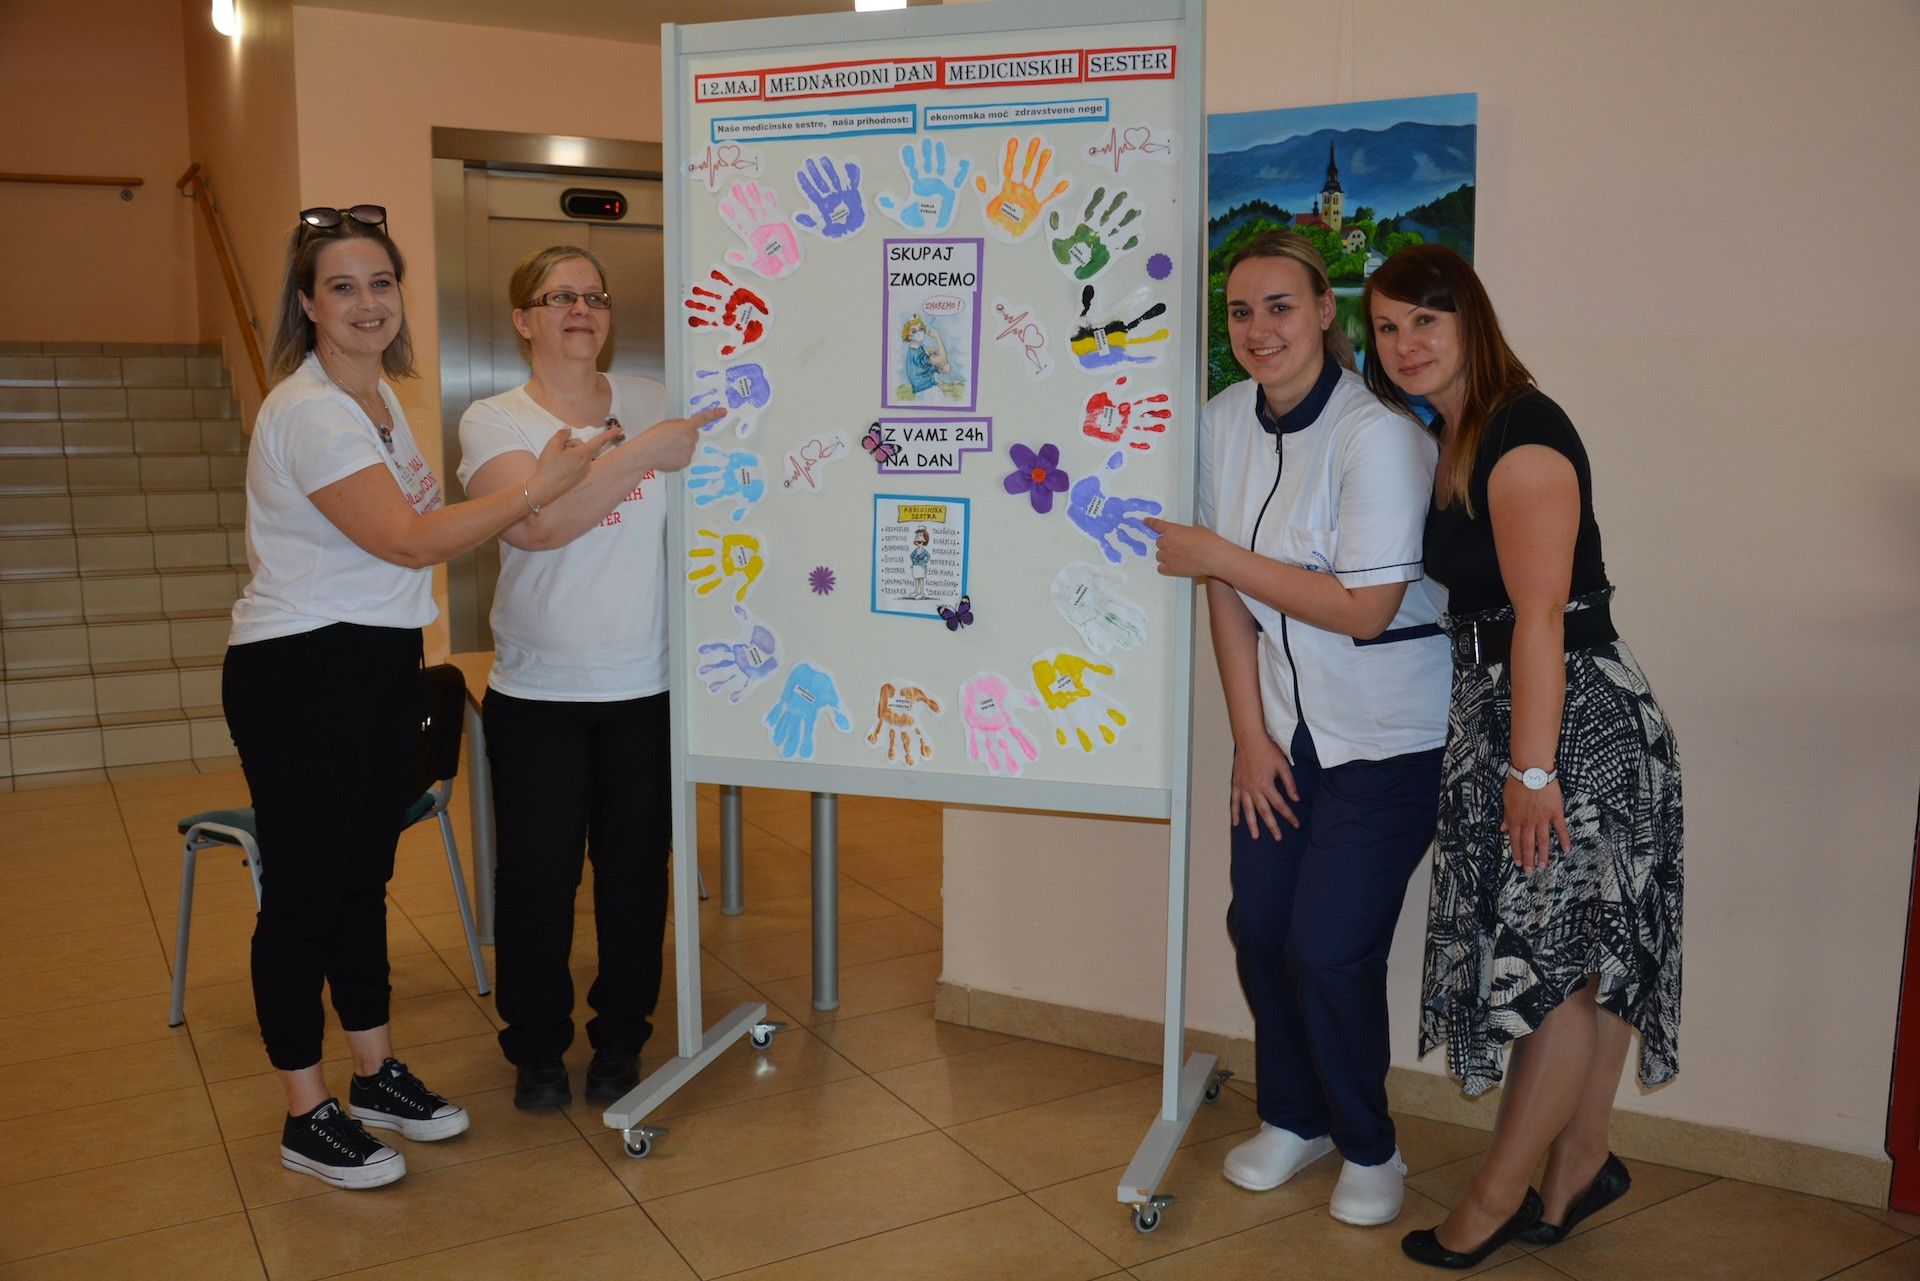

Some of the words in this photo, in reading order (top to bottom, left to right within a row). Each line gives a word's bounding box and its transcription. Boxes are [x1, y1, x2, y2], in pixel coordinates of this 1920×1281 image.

[701, 79, 757, 96] 12.MAJ
[770, 68, 889, 94] MEDNARODNI
[895, 63, 933, 83] DAN
[950, 58, 1073, 81] MEDICINSKIH
[1090, 52, 1168, 73] SESTER
[717, 123, 740, 133] Naše
[742, 121, 793, 132] medicinske
[795, 118, 827, 130] sestre,
[832, 116, 855, 127] naša
[857, 114, 909, 127] prihodnost:
[930, 112, 985, 122] ekonomska
[1015, 105, 1075, 117] zdravstvene
[1078, 105, 1103, 115] nege
[890, 246, 954, 261] SKUPAJ
[890, 271, 975, 287] ZMOREMO
[884, 428, 896, 442] Z
[903, 428, 948, 442] VAMI
[955, 427, 984, 442] 24h
[886, 454, 909, 467] NA
[917, 453, 953, 467] DAN
